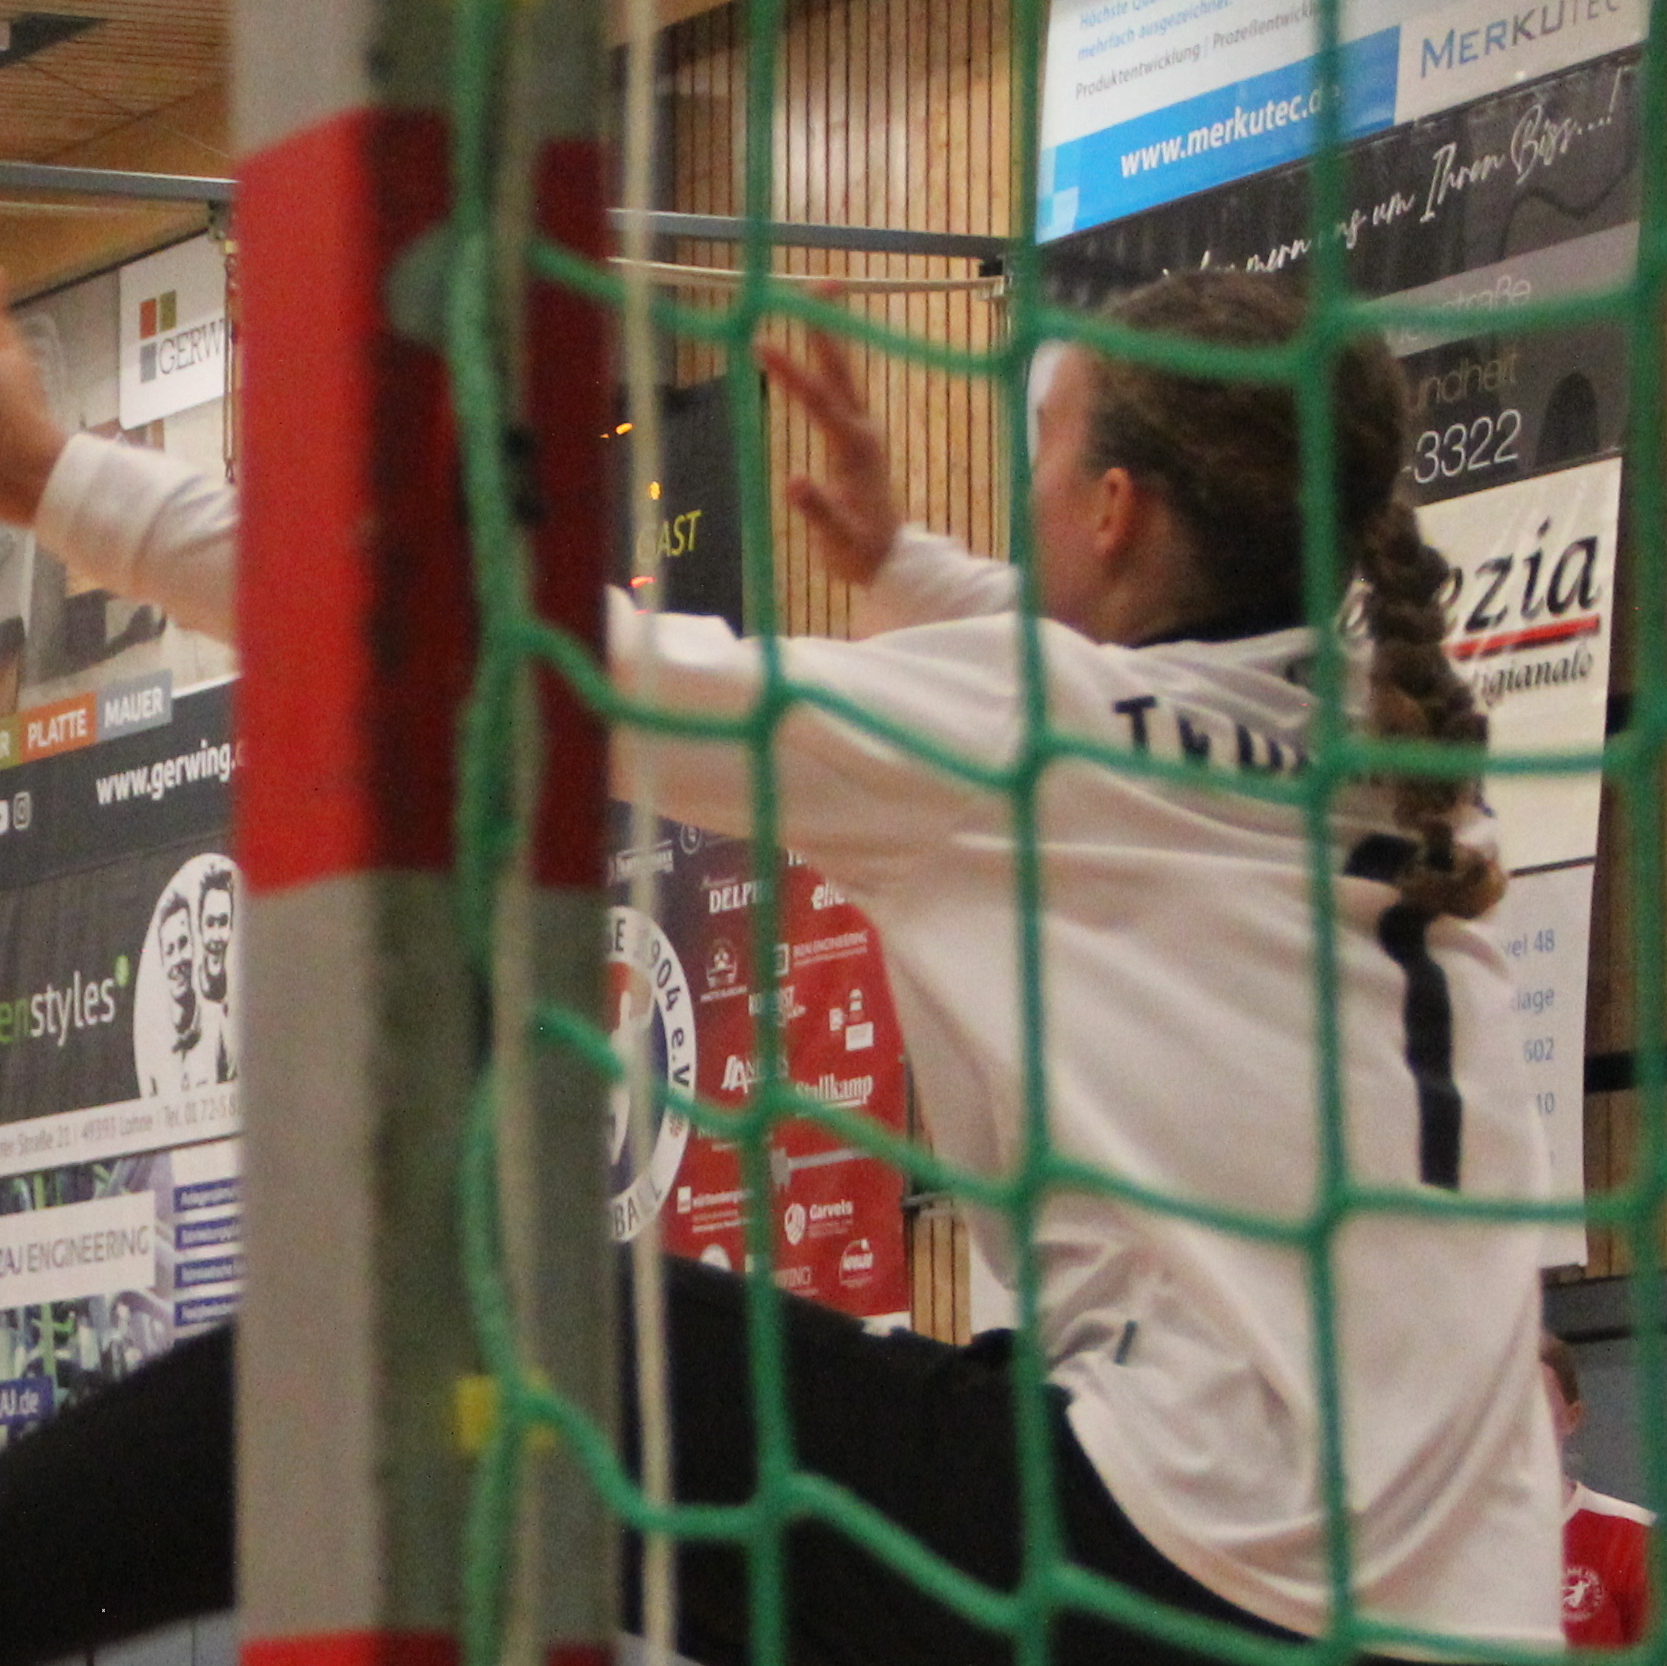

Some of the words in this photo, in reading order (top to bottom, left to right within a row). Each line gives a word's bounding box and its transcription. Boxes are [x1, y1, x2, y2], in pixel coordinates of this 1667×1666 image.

[1075, 41, 1202, 99] Produktentwicklung
[27, 707, 88, 750] PLATTE
[103, 686, 164, 729] MAUER
[26, 1225, 149, 1273] ENGINEERING
